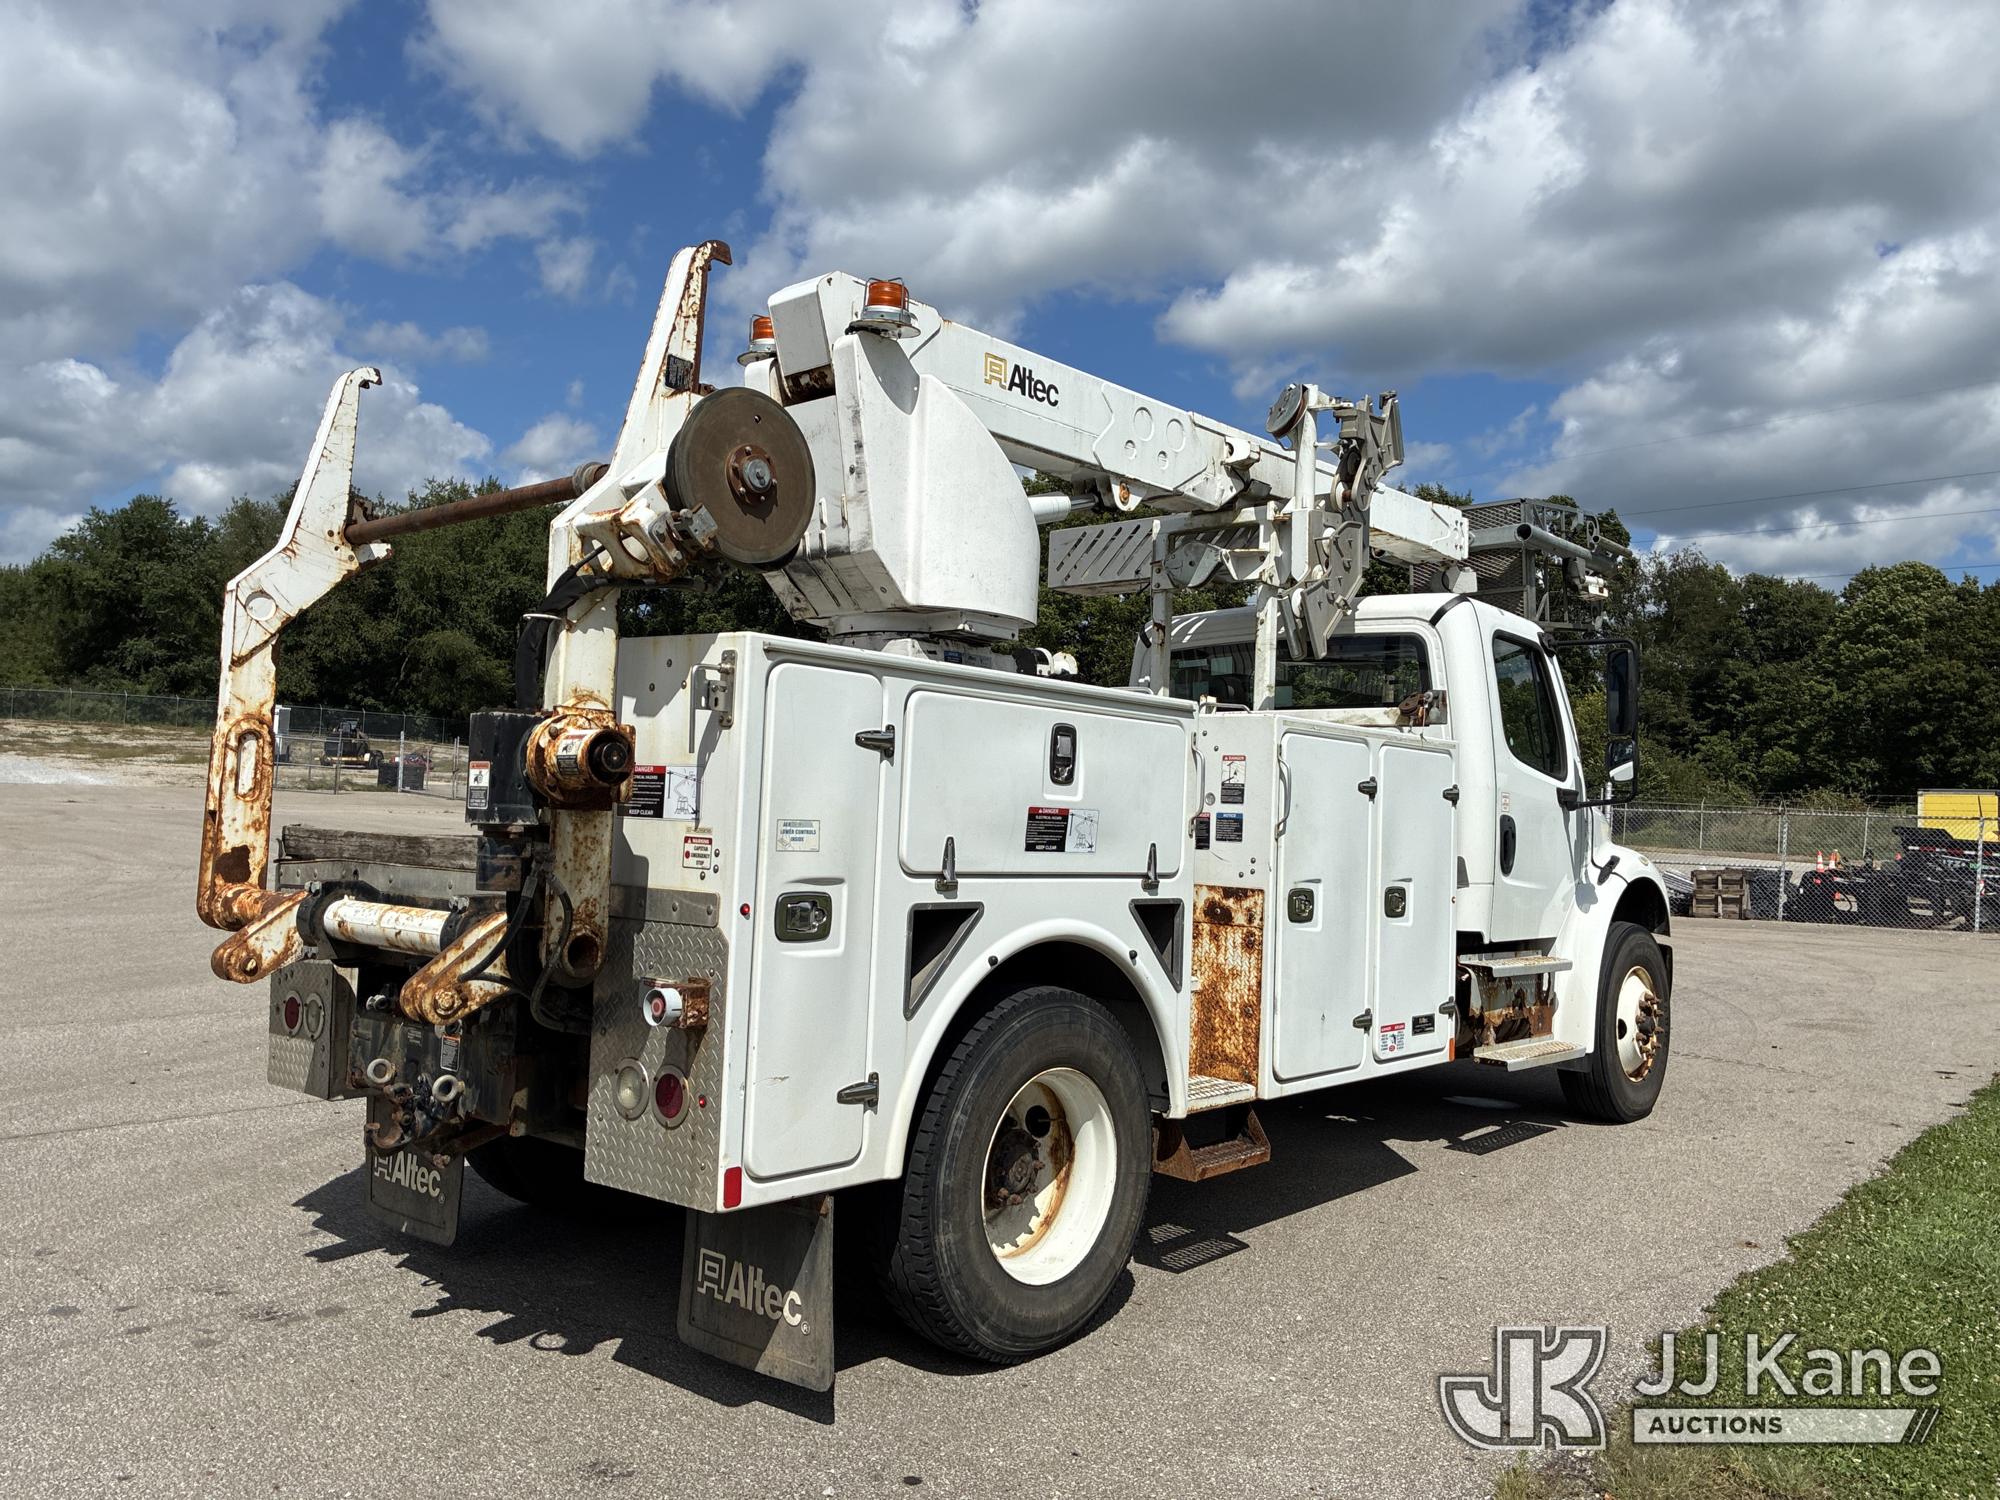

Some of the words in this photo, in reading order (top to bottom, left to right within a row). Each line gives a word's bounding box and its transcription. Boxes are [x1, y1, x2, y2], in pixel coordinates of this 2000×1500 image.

[1008, 364, 1059, 407] Altec
[391, 1150, 441, 1198] Altec
[724, 1260, 803, 1327] Altec
